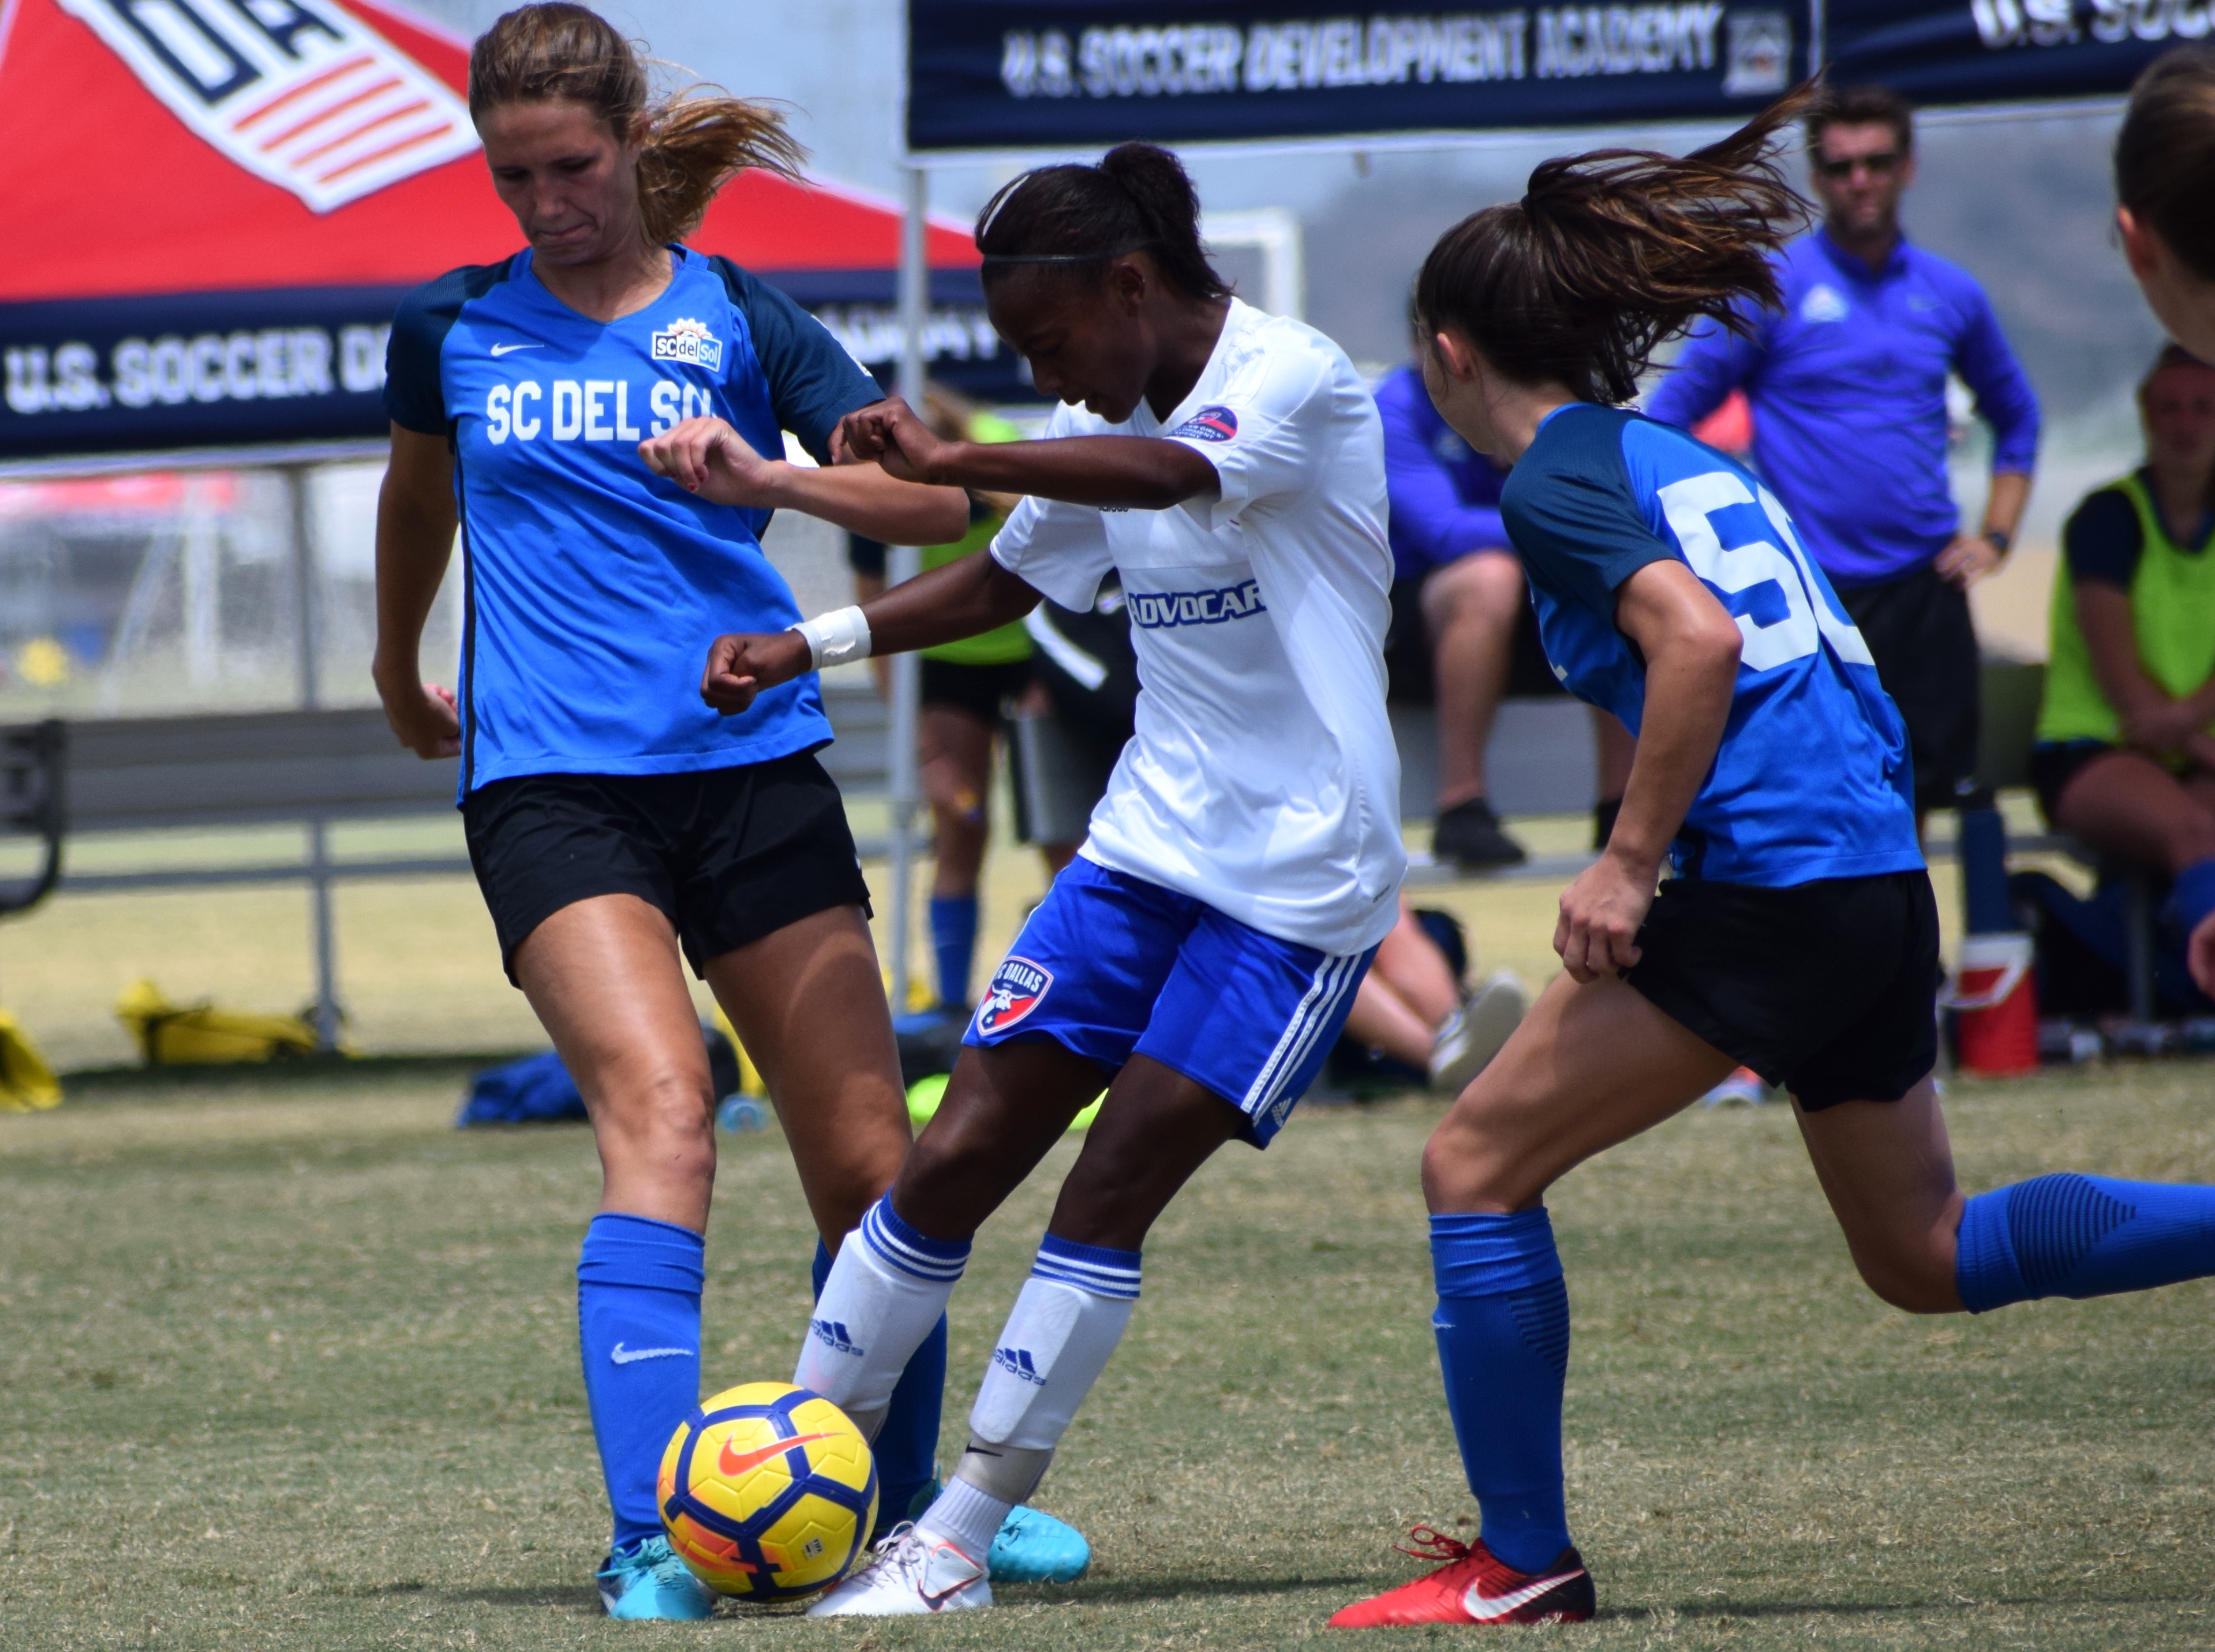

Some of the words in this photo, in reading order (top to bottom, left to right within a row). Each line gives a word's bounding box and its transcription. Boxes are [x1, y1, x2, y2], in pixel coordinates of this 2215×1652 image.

[2088, 0, 2215, 43] SOC
[1079, 25, 1243, 96] SOCCER
[1244, 13, 1527, 91] DEVELOPMENT
[1535, 3, 1724, 78] ACADEMY
[5, 343, 110, 414] U.S.
[113, 328, 334, 407] SOCCER
[657, 338, 676, 355] SC
[679, 339, 698, 358] del
[487, 380, 541, 445] SC
[552, 380, 639, 441] DEL
[1003, 962, 1043, 992] DALLAS
